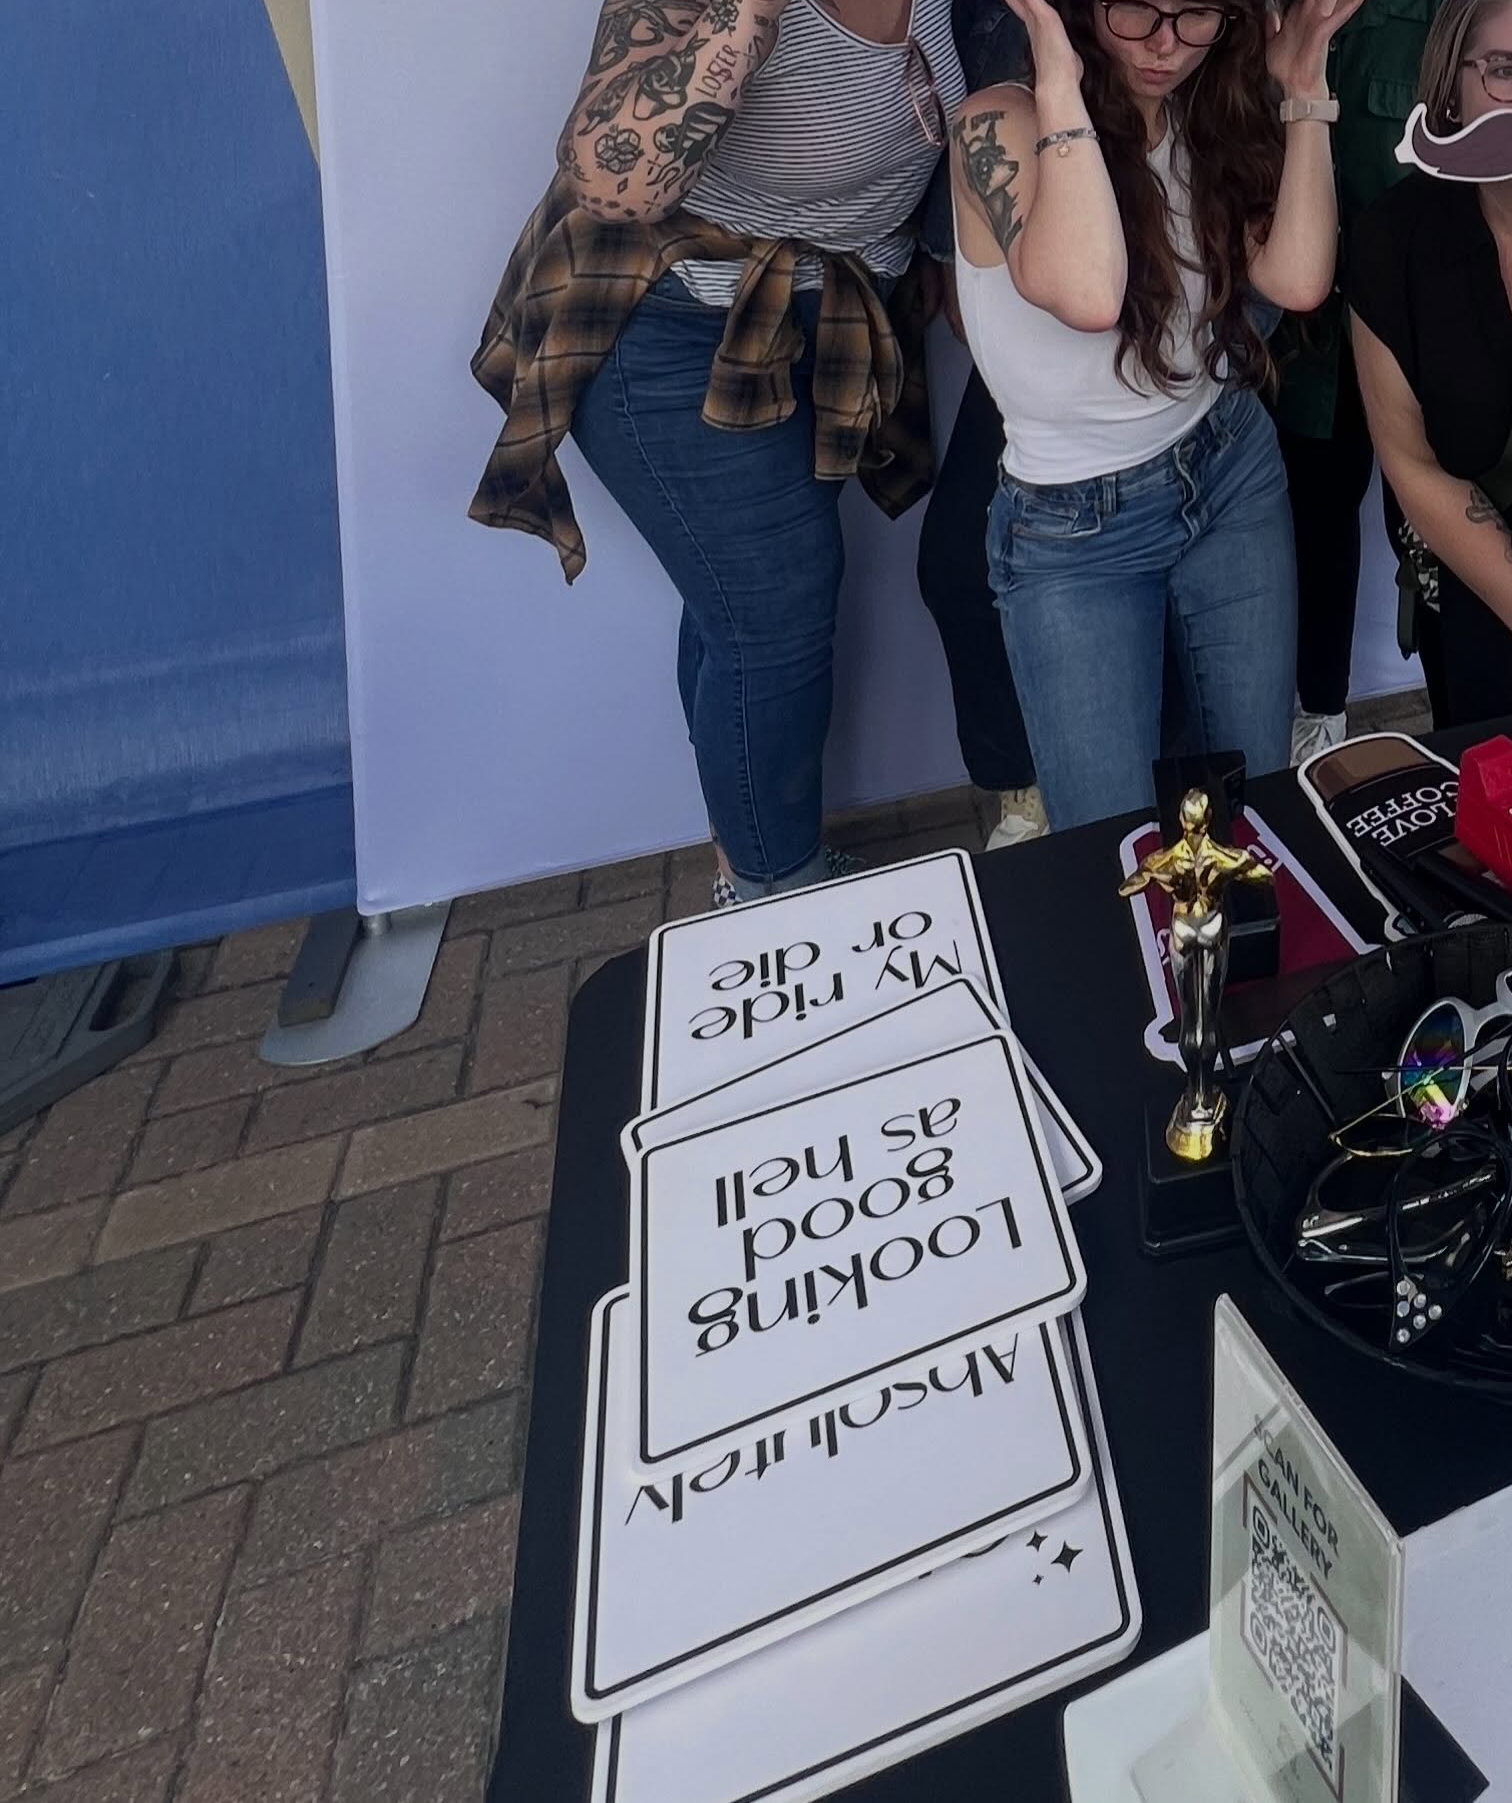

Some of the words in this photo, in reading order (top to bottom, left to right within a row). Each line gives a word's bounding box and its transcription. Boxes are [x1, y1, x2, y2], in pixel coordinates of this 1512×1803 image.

[1371, 801, 1456, 847] LOVE
[709, 940, 821, 993] die
[851, 910, 934, 955] or
[874, 940, 964, 992] My
[689, 971, 844, 1041] ride
[880, 1097, 962, 1153] as
[714, 1134, 854, 1229] hell
[742, 1146, 955, 1283] good
[686, 1196, 1025, 1359] Looking
[1257, 1457, 1333, 1580] GALLERY
[1303, 1484, 1339, 1559] FOR
